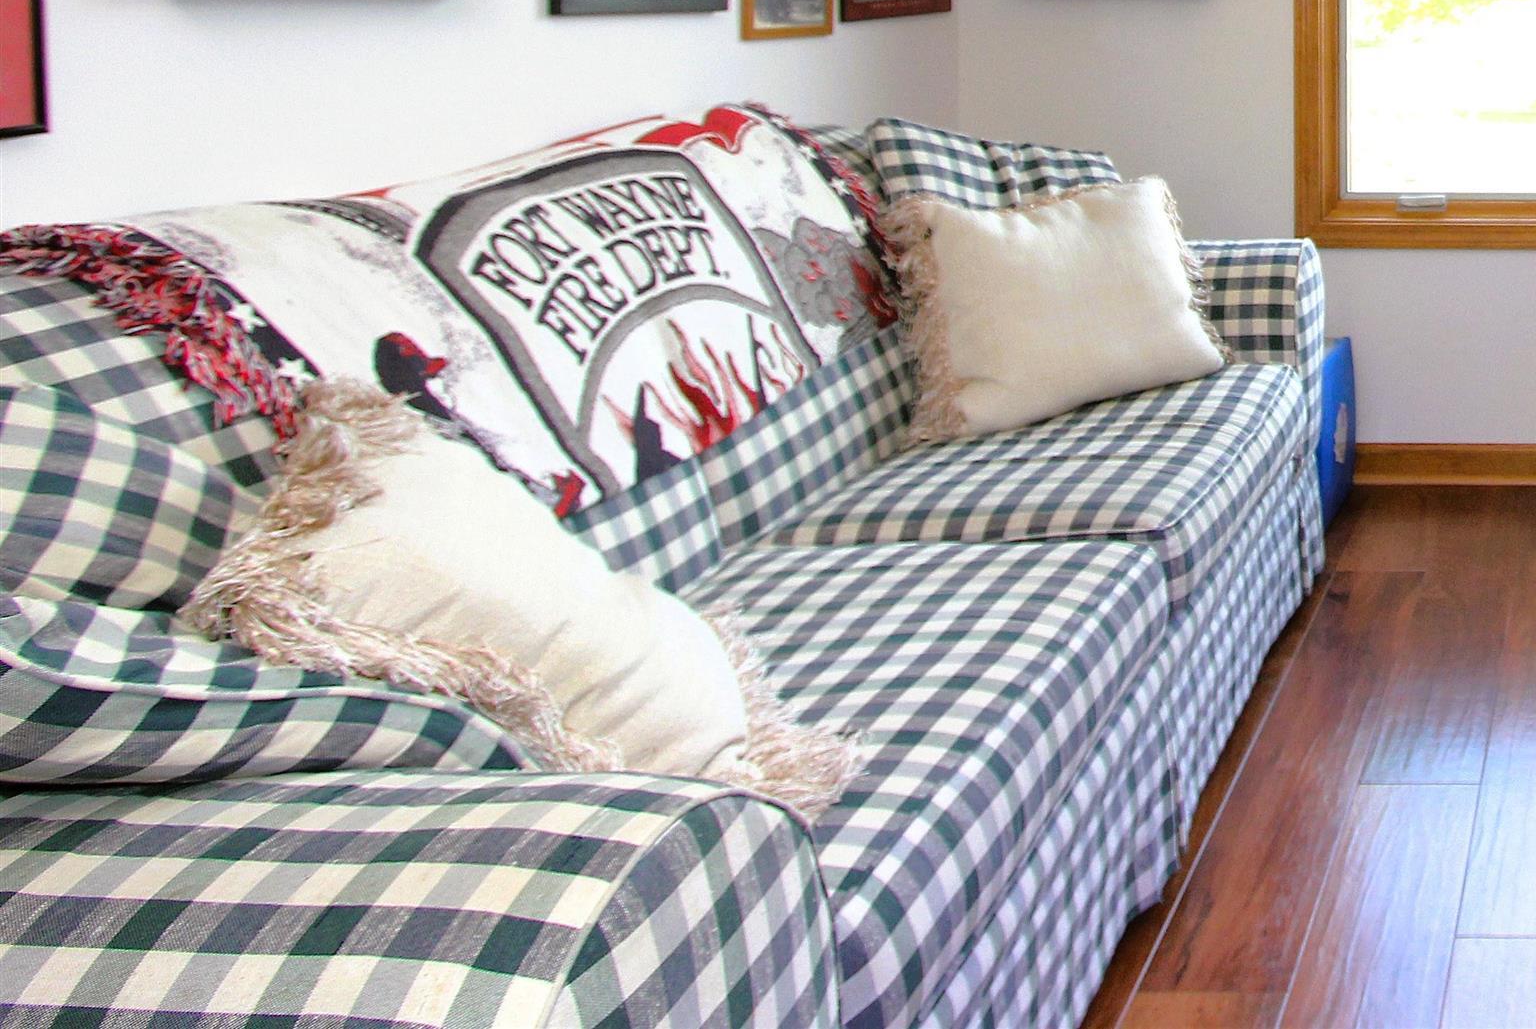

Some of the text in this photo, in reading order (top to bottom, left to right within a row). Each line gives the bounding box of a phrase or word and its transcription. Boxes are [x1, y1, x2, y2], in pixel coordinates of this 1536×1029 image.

[472, 176, 706, 308] FORT WAYNE
[537, 225, 731, 364] FIRE DEPT.
